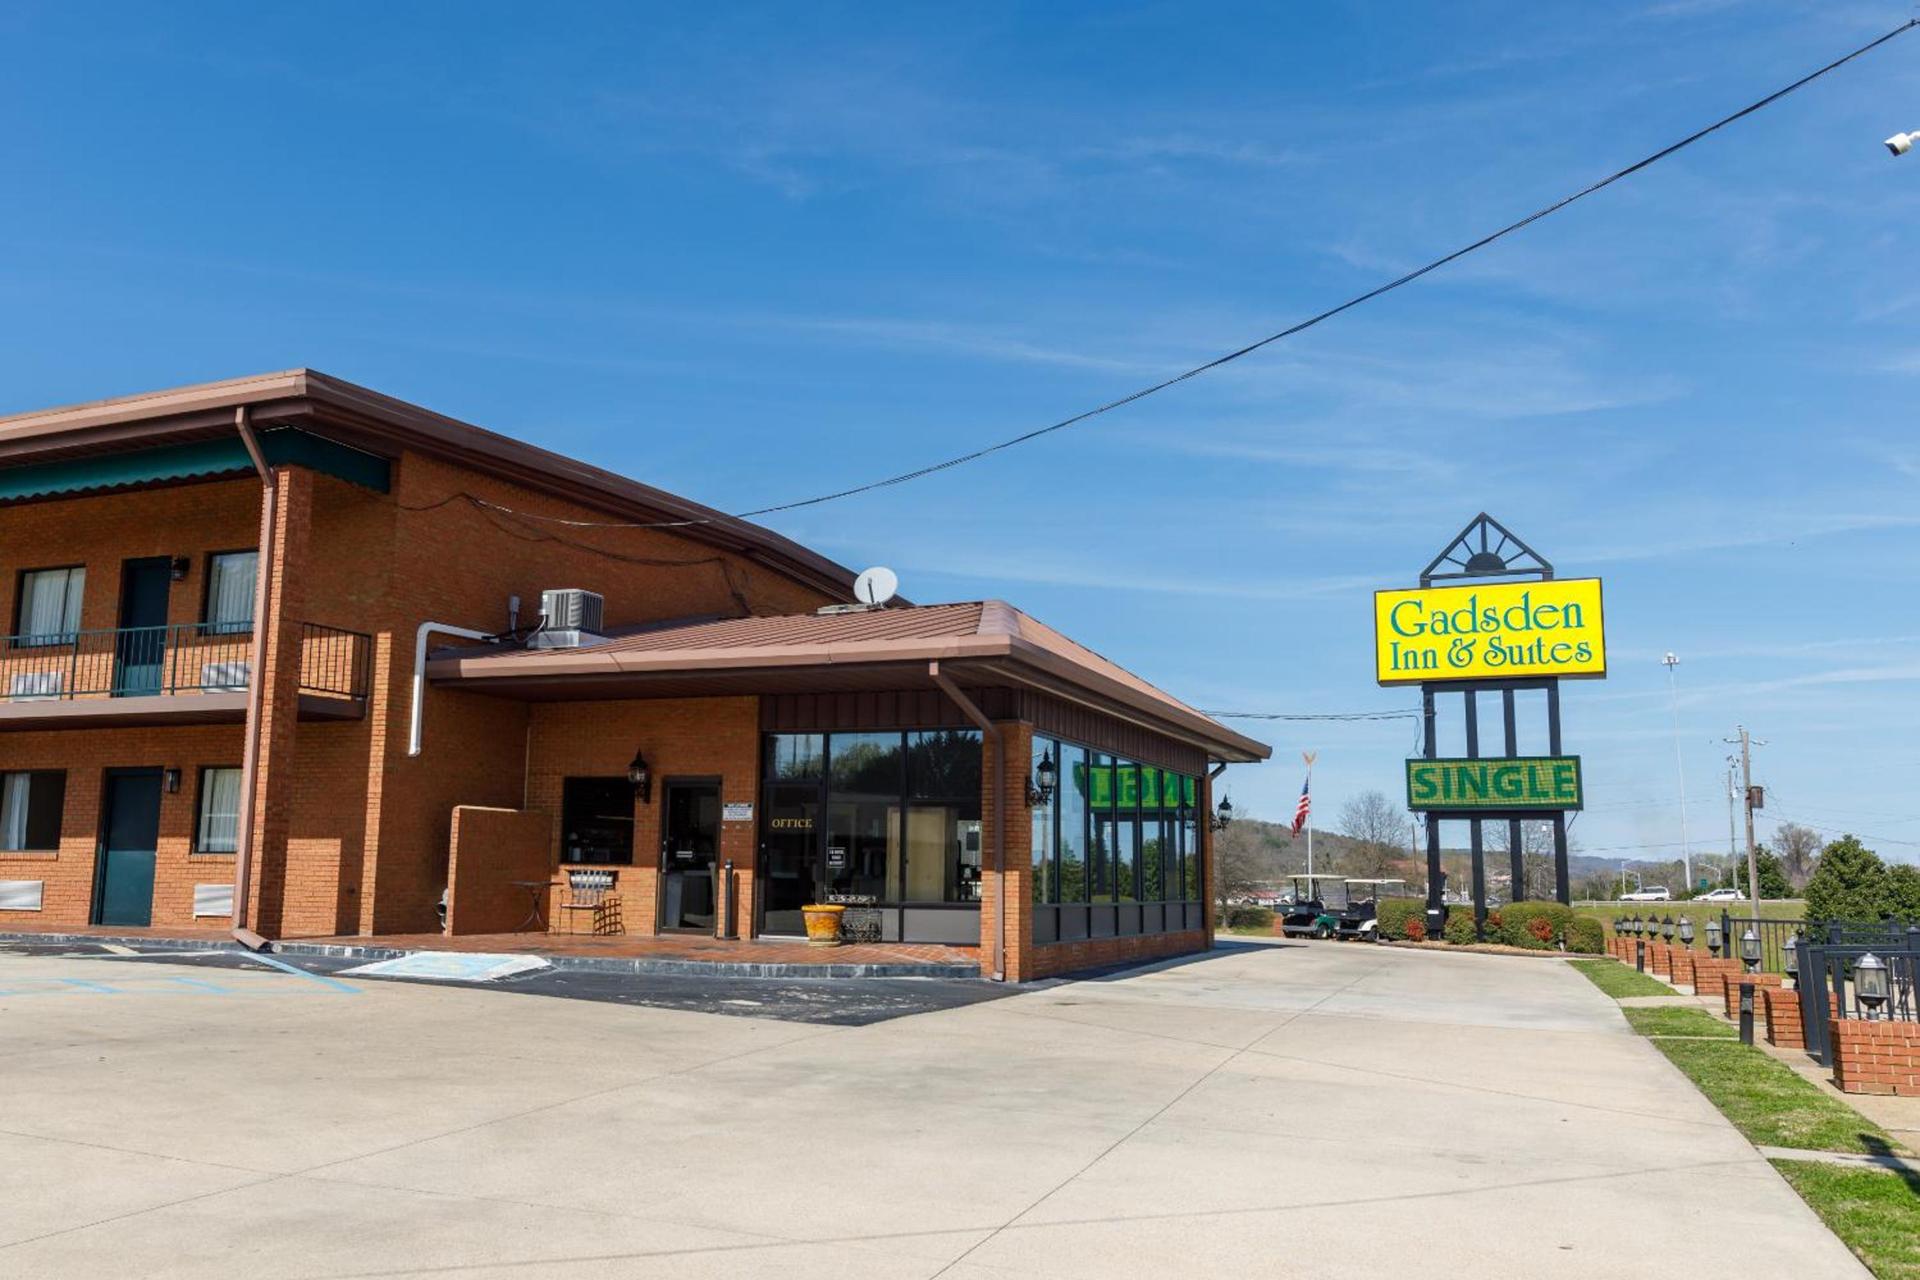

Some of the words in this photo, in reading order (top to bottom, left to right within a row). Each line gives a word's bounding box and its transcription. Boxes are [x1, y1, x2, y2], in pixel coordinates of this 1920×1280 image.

[1390, 591, 1584, 637] Gadsden
[1389, 641, 1439, 670] Inn
[1447, 637, 1477, 668] &
[1483, 635, 1593, 667] Suites
[1413, 764, 1575, 799] SINGLE
[771, 818, 813, 828] OFFICE
